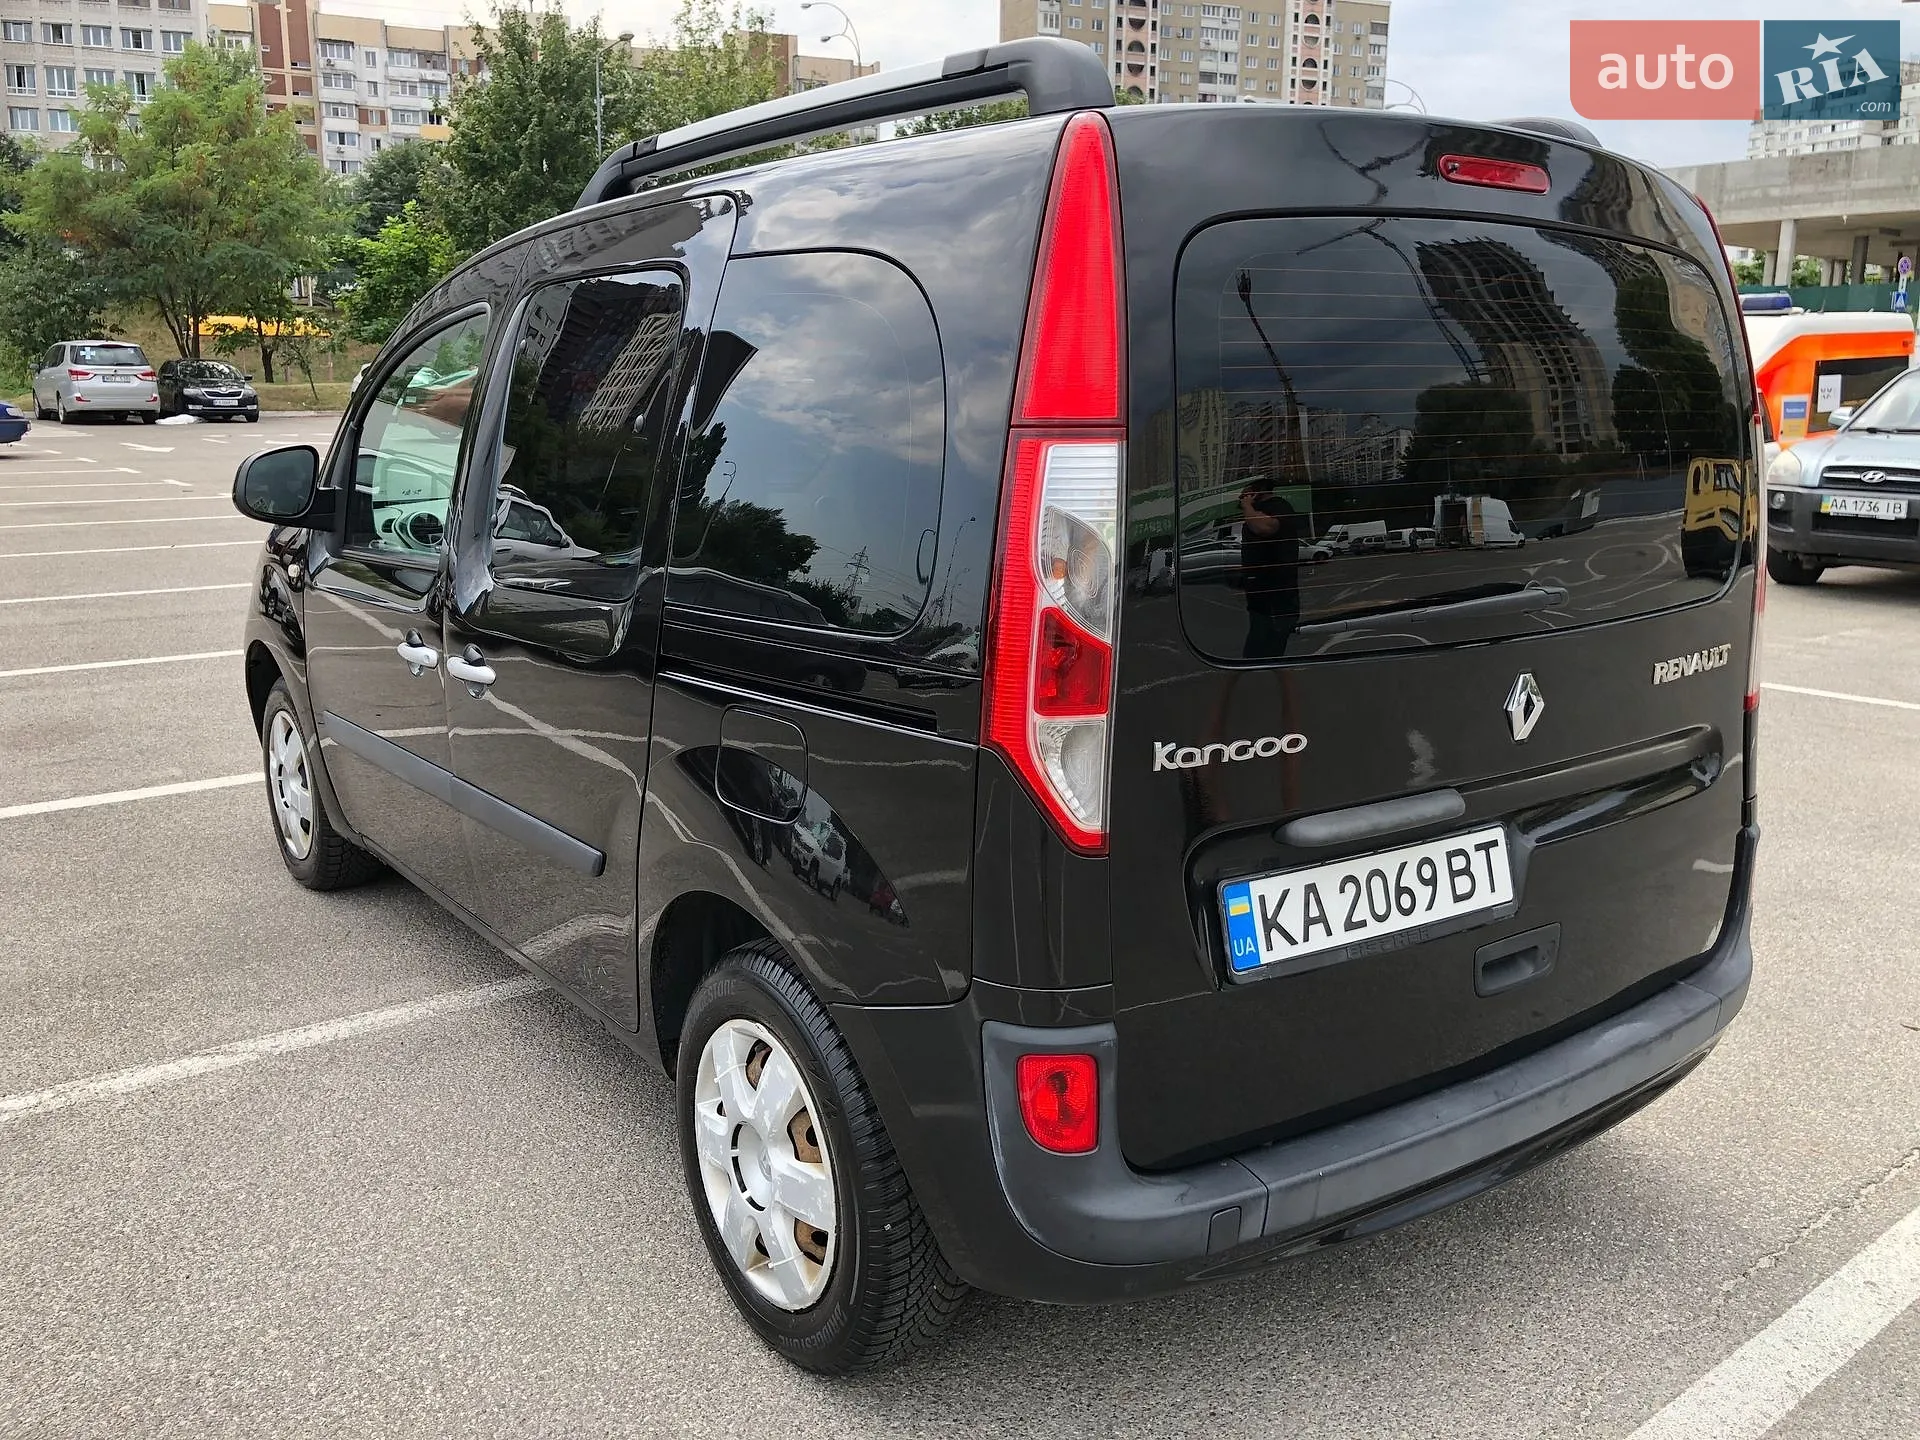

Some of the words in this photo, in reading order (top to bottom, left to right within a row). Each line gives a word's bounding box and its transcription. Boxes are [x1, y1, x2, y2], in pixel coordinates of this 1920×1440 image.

[1830, 498, 1847, 511] AA
[1852, 500, 1880, 513] 1736
[1886, 501, 1902, 514] IB
[1653, 643, 1732, 684] RENAULT
[1152, 733, 1308, 772] Kangoo
[1258, 883, 1332, 952] KA
[1339, 856, 1438, 932] 2069
[1446, 839, 1499, 904] BT
[1233, 937, 1256, 957] UA
